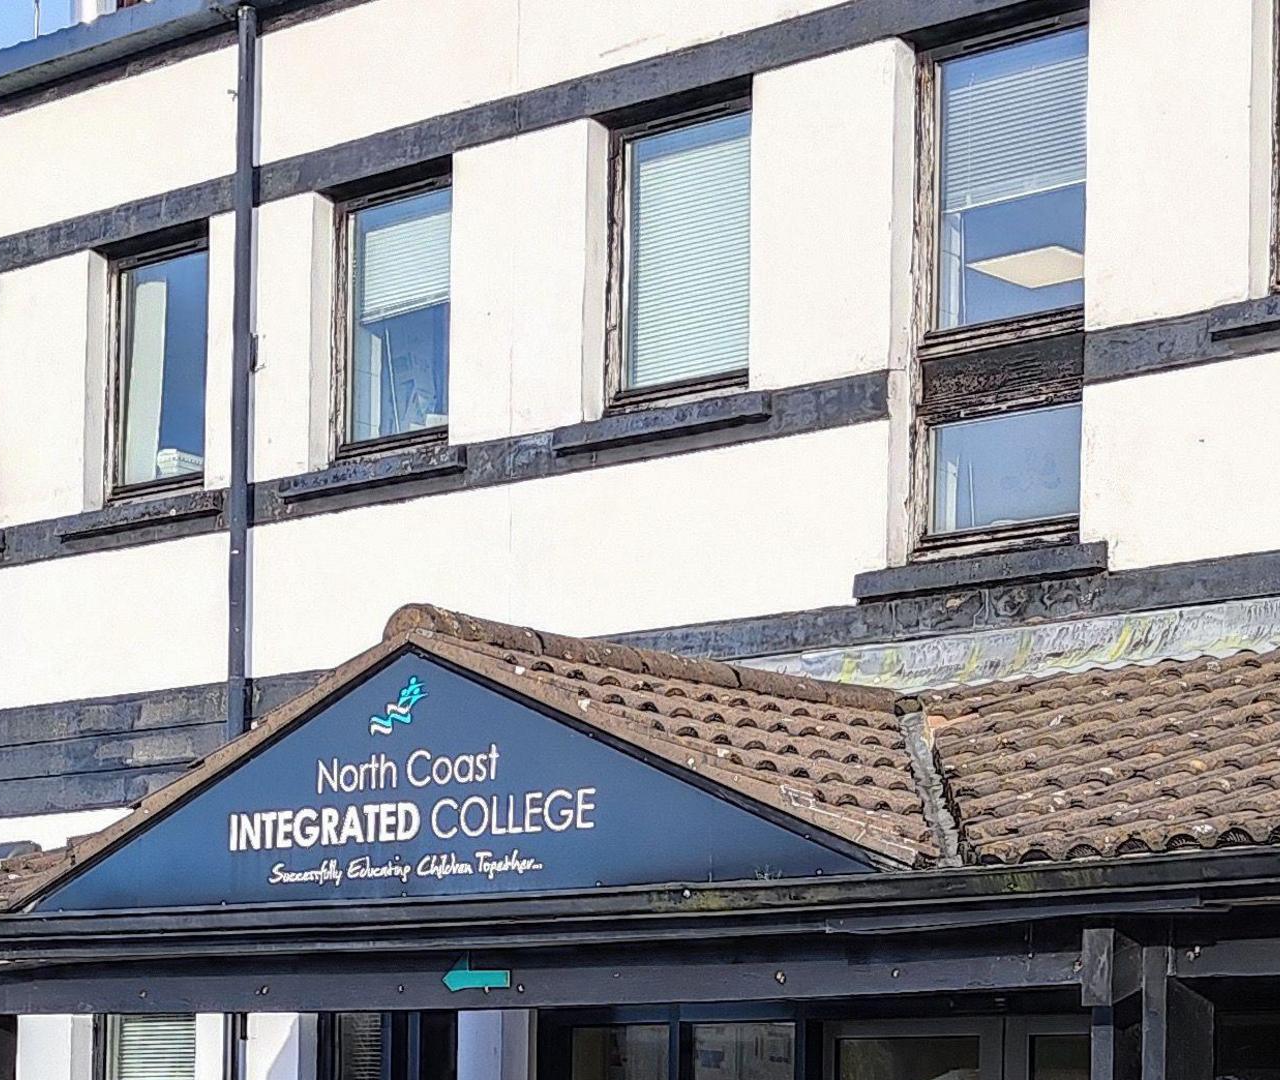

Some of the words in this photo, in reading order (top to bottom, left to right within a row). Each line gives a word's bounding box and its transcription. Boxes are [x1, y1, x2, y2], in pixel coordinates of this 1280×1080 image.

[317, 753, 398, 794] North
[406, 743, 500, 788] Coast
[229, 802, 420, 852] INTEGRATED
[431, 788, 597, 840] COLLEGE
[269, 857, 343, 886] Successfully
[348, 856, 410, 882] Educating
[417, 853, 474, 879] Children
